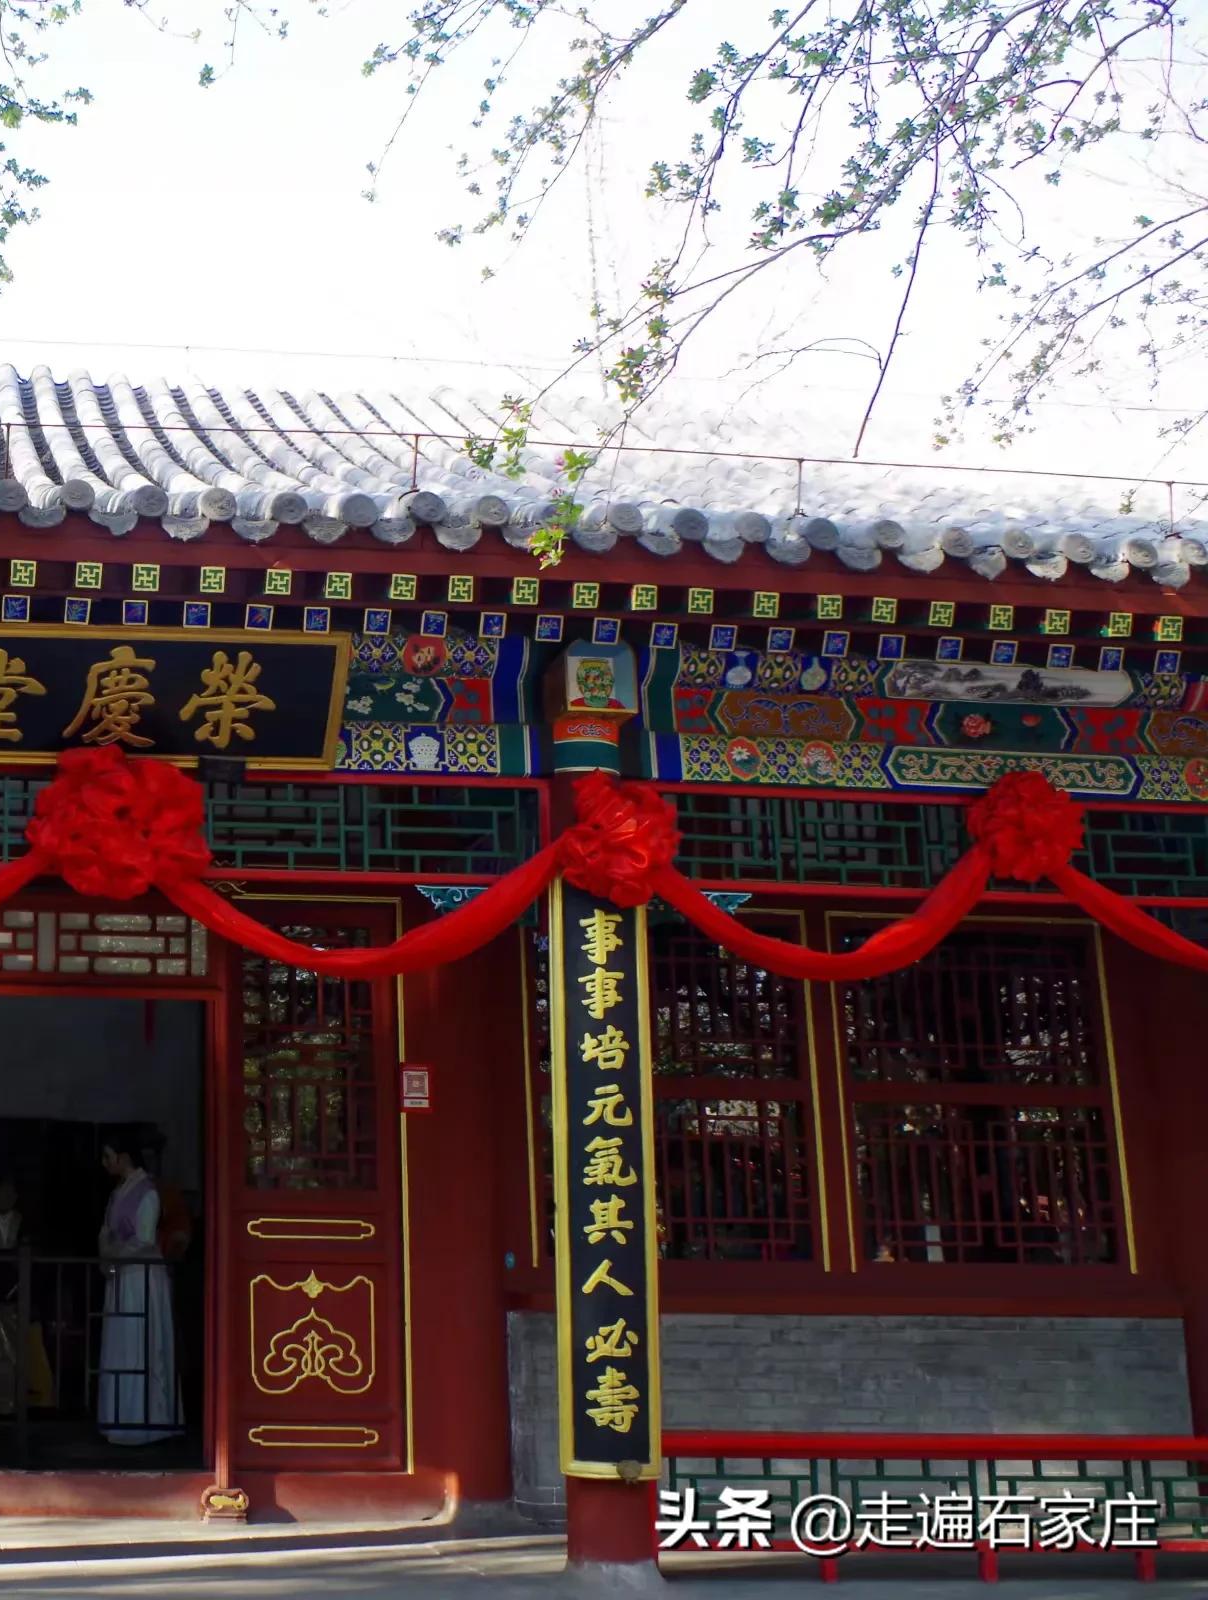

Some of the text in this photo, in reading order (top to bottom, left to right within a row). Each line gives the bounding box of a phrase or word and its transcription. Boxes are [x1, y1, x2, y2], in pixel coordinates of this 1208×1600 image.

[577, 908, 639, 1433] 事事培元氣其人必壽
